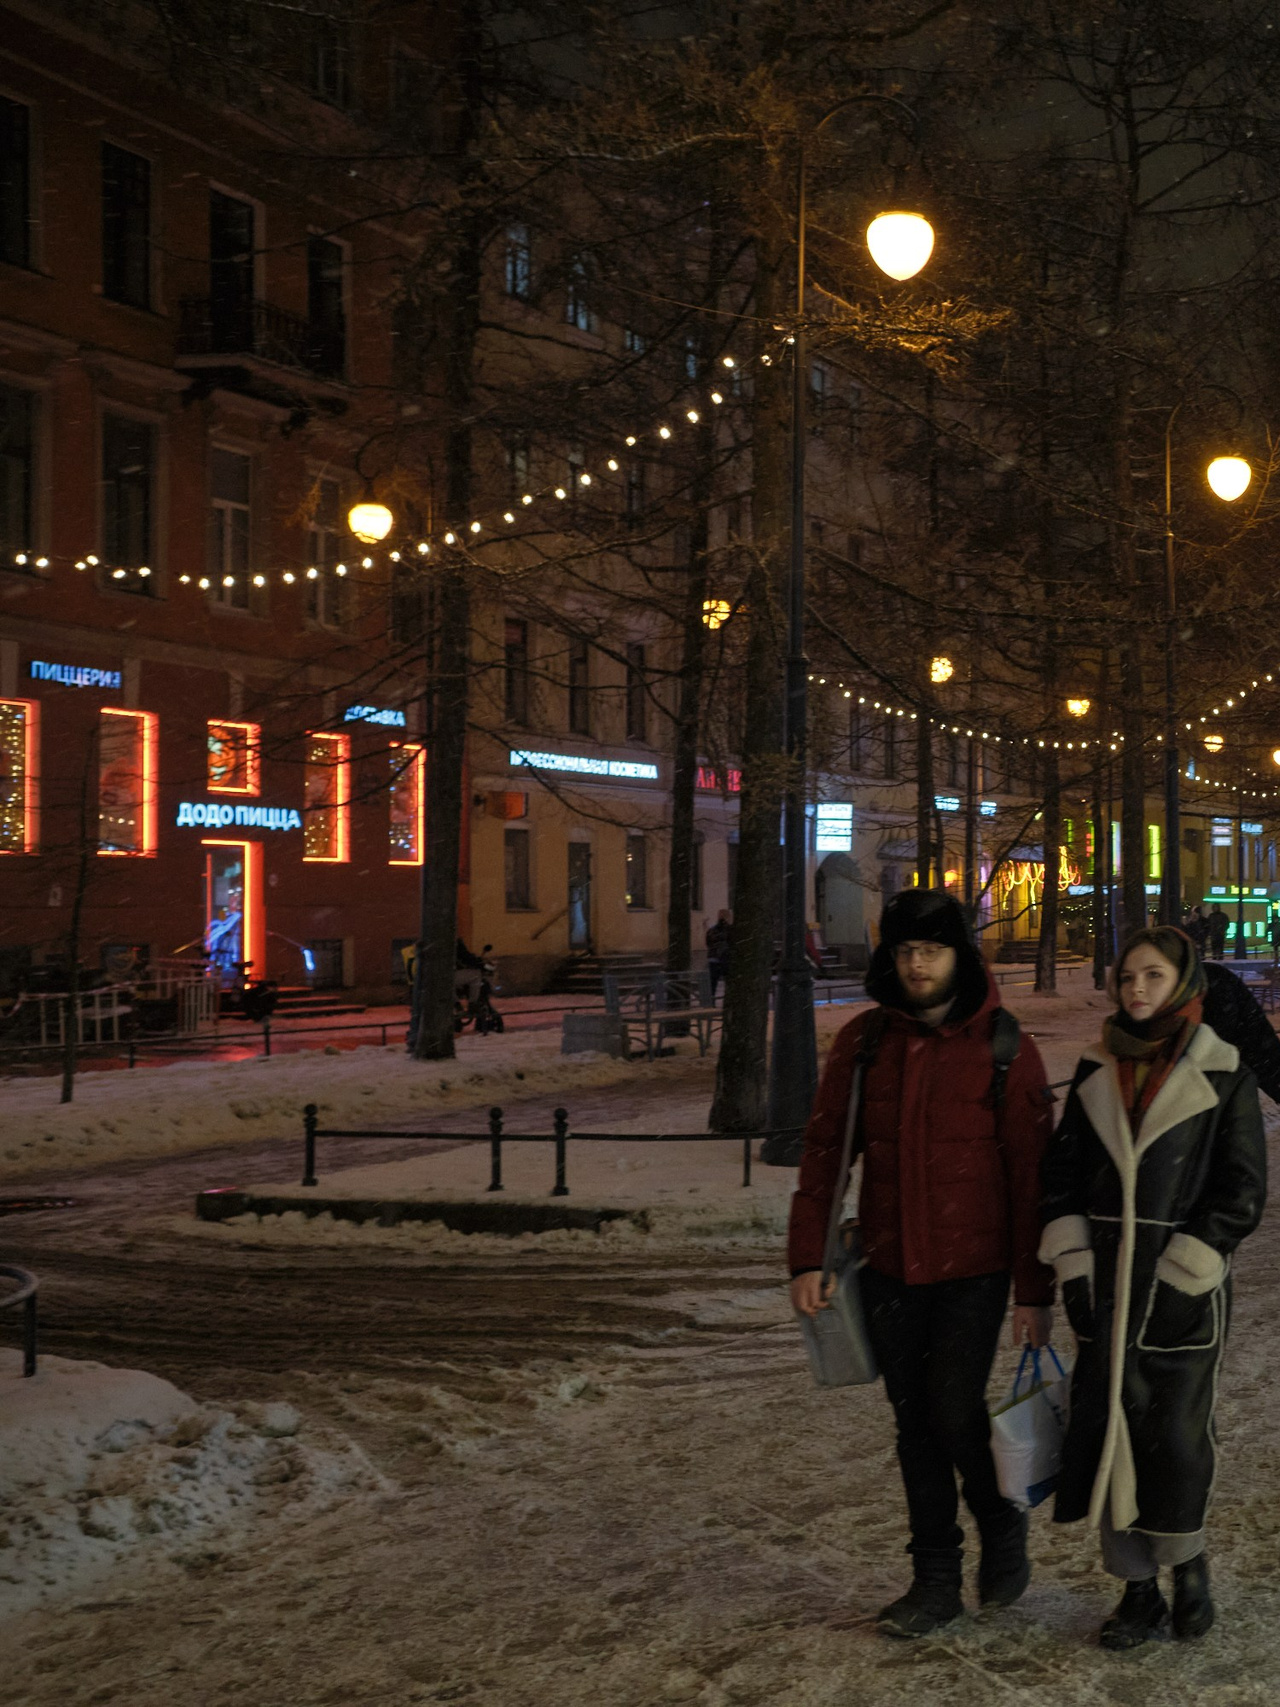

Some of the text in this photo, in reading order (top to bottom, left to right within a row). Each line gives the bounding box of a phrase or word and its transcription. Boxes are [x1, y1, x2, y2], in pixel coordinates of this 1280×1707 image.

[31, 660, 121, 688] ПИЦЦЕРИЯ
[177, 802, 302, 831] ДОДО ПИЦЦА
